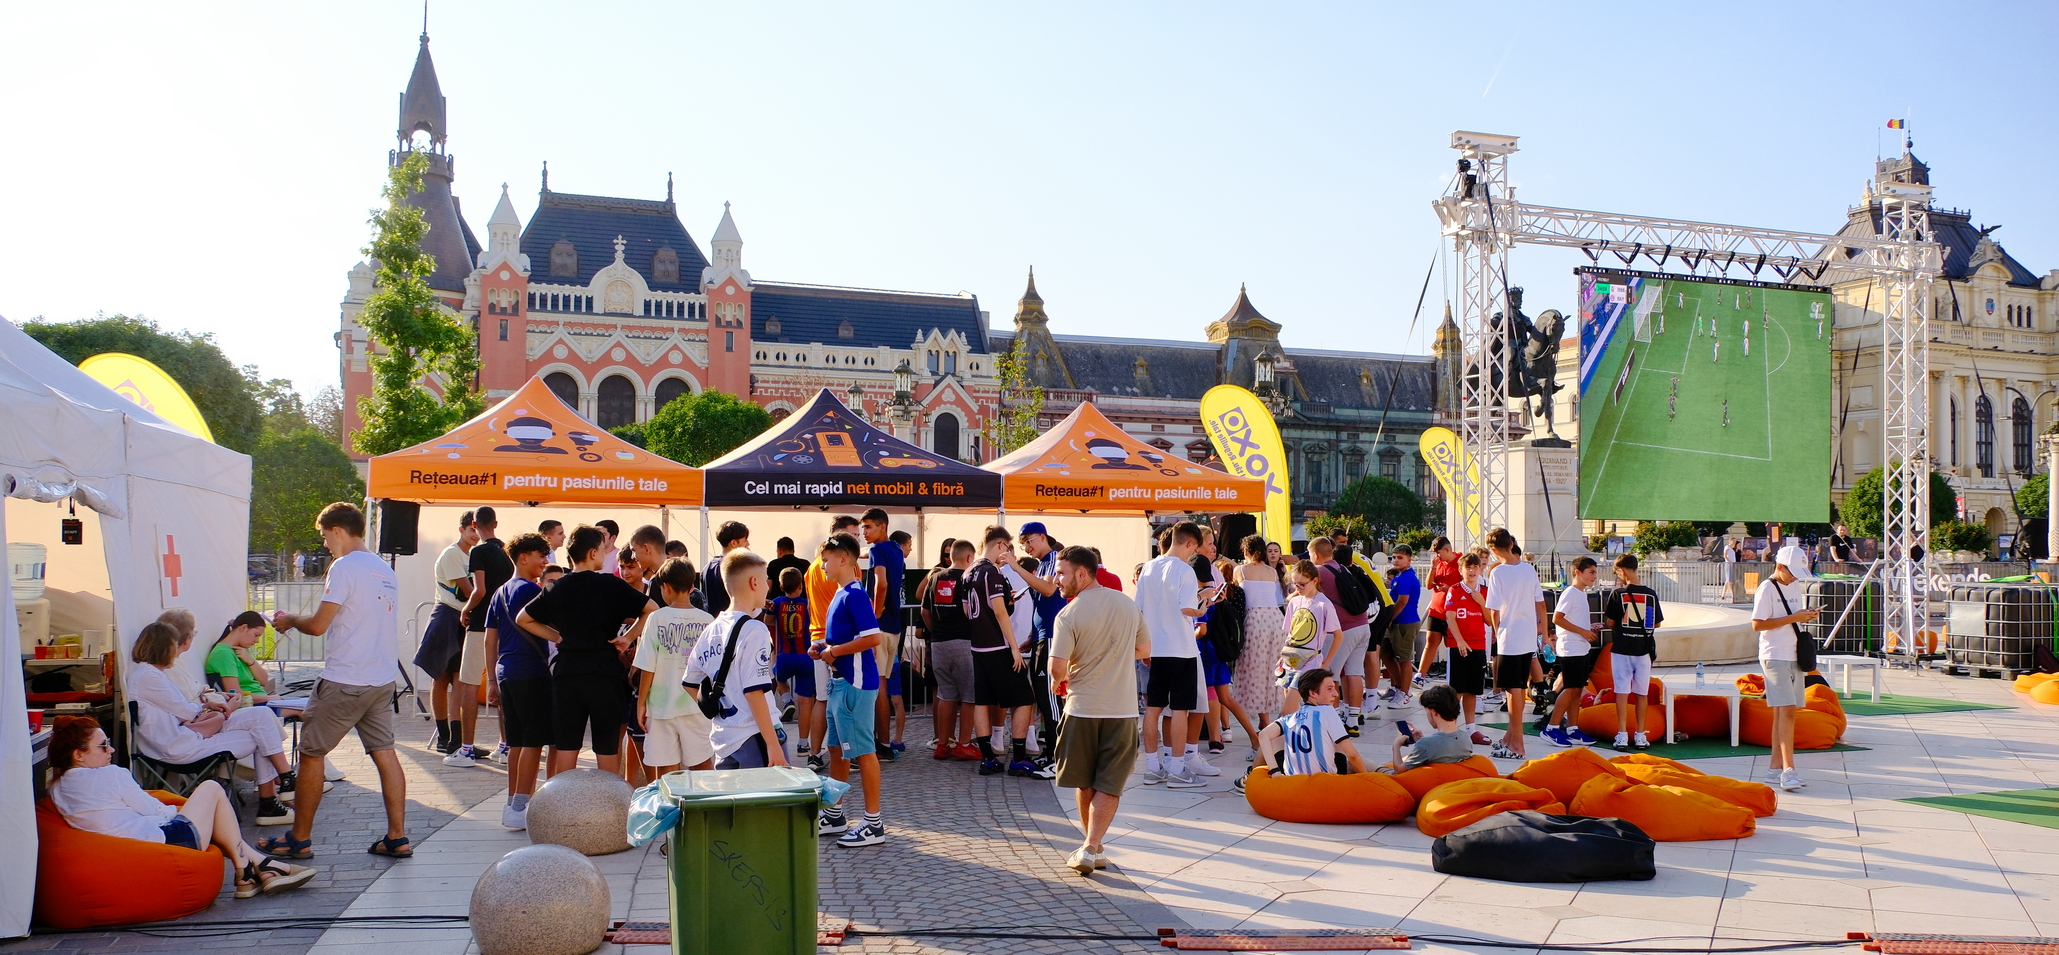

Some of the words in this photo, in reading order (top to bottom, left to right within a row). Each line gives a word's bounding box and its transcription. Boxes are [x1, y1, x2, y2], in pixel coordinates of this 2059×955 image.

[410, 470, 497, 488] Rețeaua#1
[503, 473, 558, 490] pentru
[562, 474, 635, 493] pasiunile
[638, 477, 668, 492] tale
[744, 480, 770, 495] Cel
[774, 480, 801, 495] mai
[804, 480, 842, 498] rapid
[846, 482, 870, 496] net
[874, 481, 914, 496] mobil
[917, 482, 929, 496] &
[932, 482, 965, 497] fibră
[1035, 484, 1104, 502] Rețeaua#1
[1108, 486, 1151, 502] pentru
[1154, 487, 1210, 503] pasiunile
[1214, 488, 1238, 500] tale
[1880, 567, 1991, 592] Wekends
[782, 612, 803, 634] 10
[1292, 724, 1312, 754] 10
